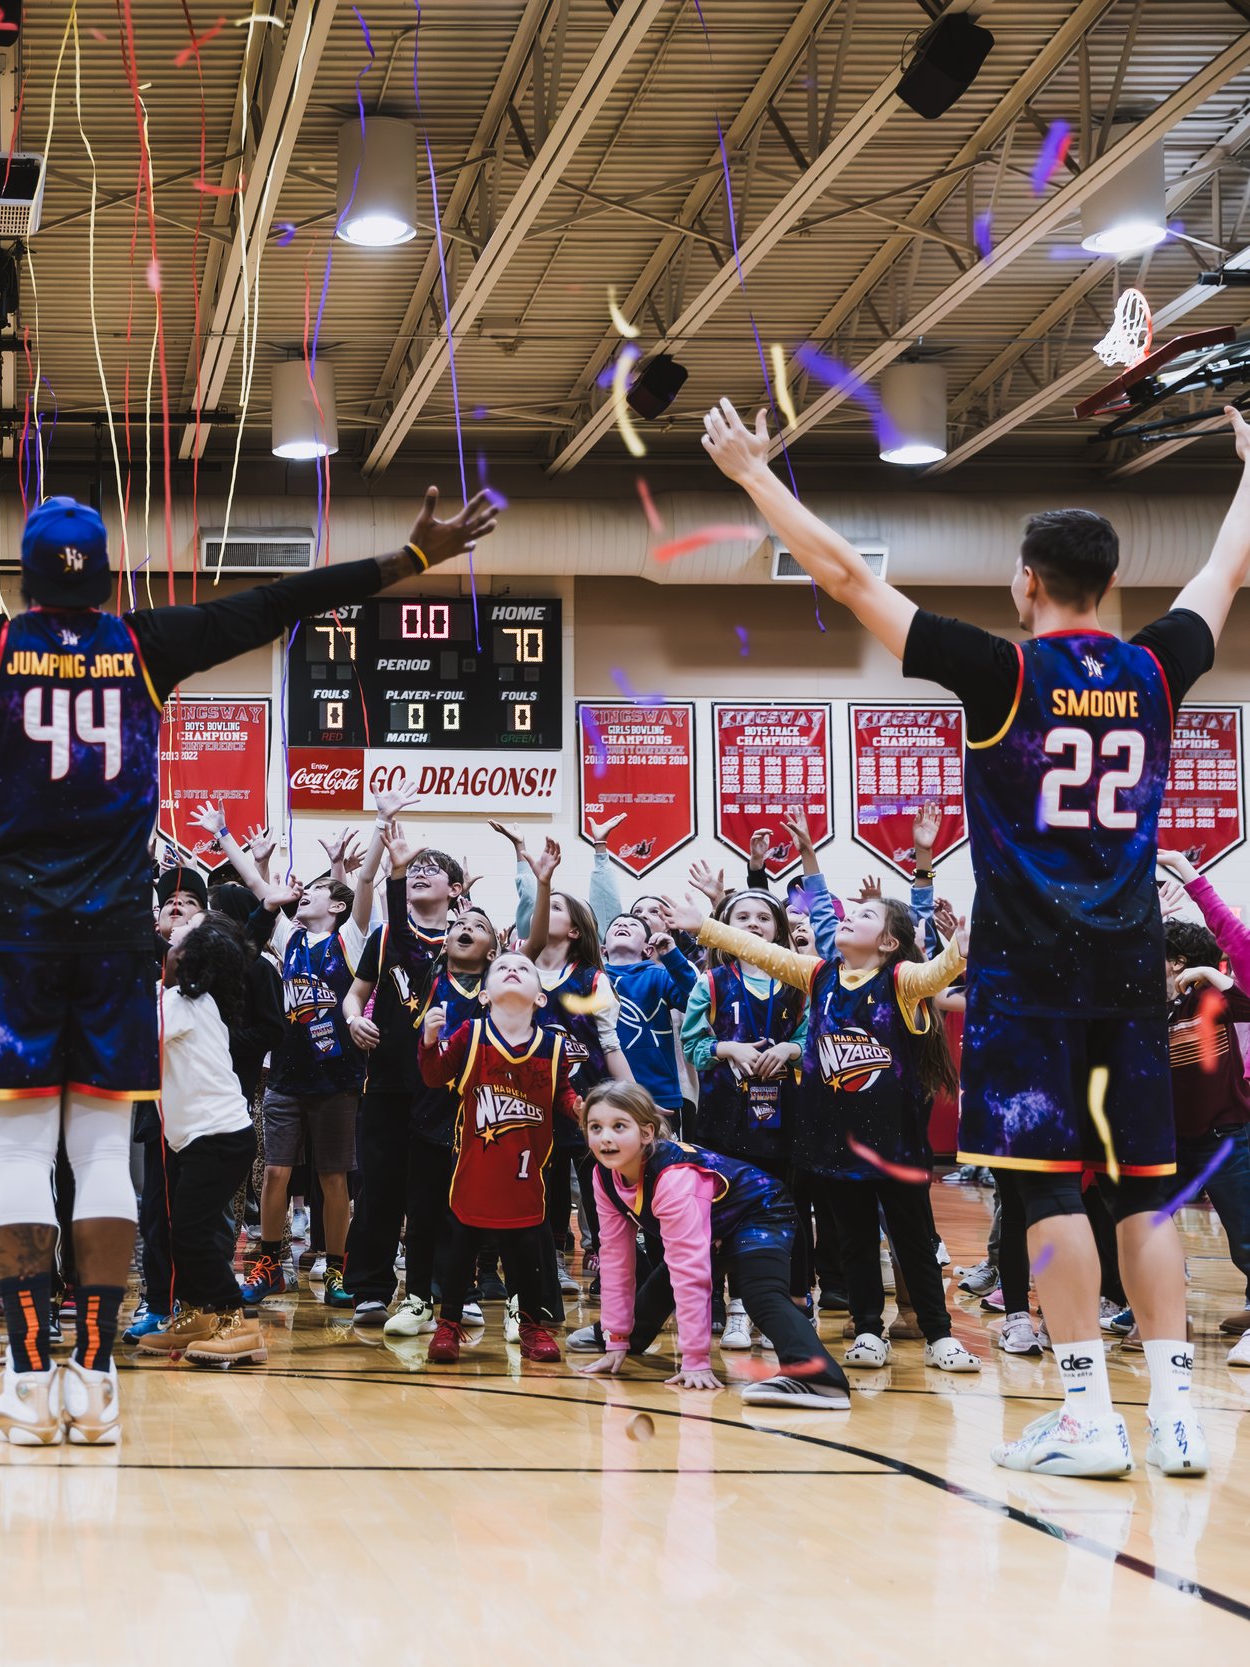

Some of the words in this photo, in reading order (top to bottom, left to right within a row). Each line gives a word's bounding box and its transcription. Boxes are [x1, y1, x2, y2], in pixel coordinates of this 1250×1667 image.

[309, 605, 362, 619] EST
[491, 607, 546, 620] HOME
[402, 604, 449, 638] 0.0
[315, 627, 356, 660] 77
[502, 628, 543, 662] 70
[6, 652, 86, 678] JUMPING
[90, 653, 136, 678] JACK
[377, 659, 431, 671] PERIOD
[313, 689, 350, 699] FOULS
[386, 691, 465, 700] PLAYER-FOUL
[501, 691, 538, 701] FOULS
[1052, 689, 1139, 718] SMOOVE
[327, 702, 343, 729] 0
[514, 704, 531, 730] 0
[721, 711, 822, 728] KINGSWAY
[858, 712, 959, 729] KINGSWAY
[23, 687, 122, 782] 44
[185, 722, 204, 730] BOYS
[207, 722, 240, 730] BOWLING
[608, 726, 630, 734] GIRLS
[631, 726, 664, 734] BOWLING
[744, 727, 768, 735] BOYS
[769, 727, 799, 735] TRACK
[880, 728, 906, 736] GIRLS
[908, 728, 936, 736] TRACK
[177, 732, 248, 741] CHAMPIONS
[321, 732, 343, 741] RED
[386, 733, 428, 742] MATCH
[501, 735, 536, 743] GREEN
[601, 736, 672, 744] CHAMPIONS
[737, 737, 809, 745] CHAMPIONS
[873, 737, 945, 746] CHAMPIONS
[290, 768, 362, 790] Coca-Cola
[369, 766, 406, 795] GO
[417, 767, 557, 797] DRAGONS!!
[1042, 727, 1146, 829] 22
[283, 981, 337, 1013] WIZARDS
[824, 992, 833, 1015] 1
[731, 1001, 739, 1024] 1
[833, 1034, 868, 1043] HARLEM
[818, 1037, 891, 1079] WIZARDS
[493, 1085, 527, 1099] HARLEM
[473, 1086, 543, 1129] WIZARDS
[518, 1150, 530, 1178] 1
[1060, 1354, 1093, 1371] de
